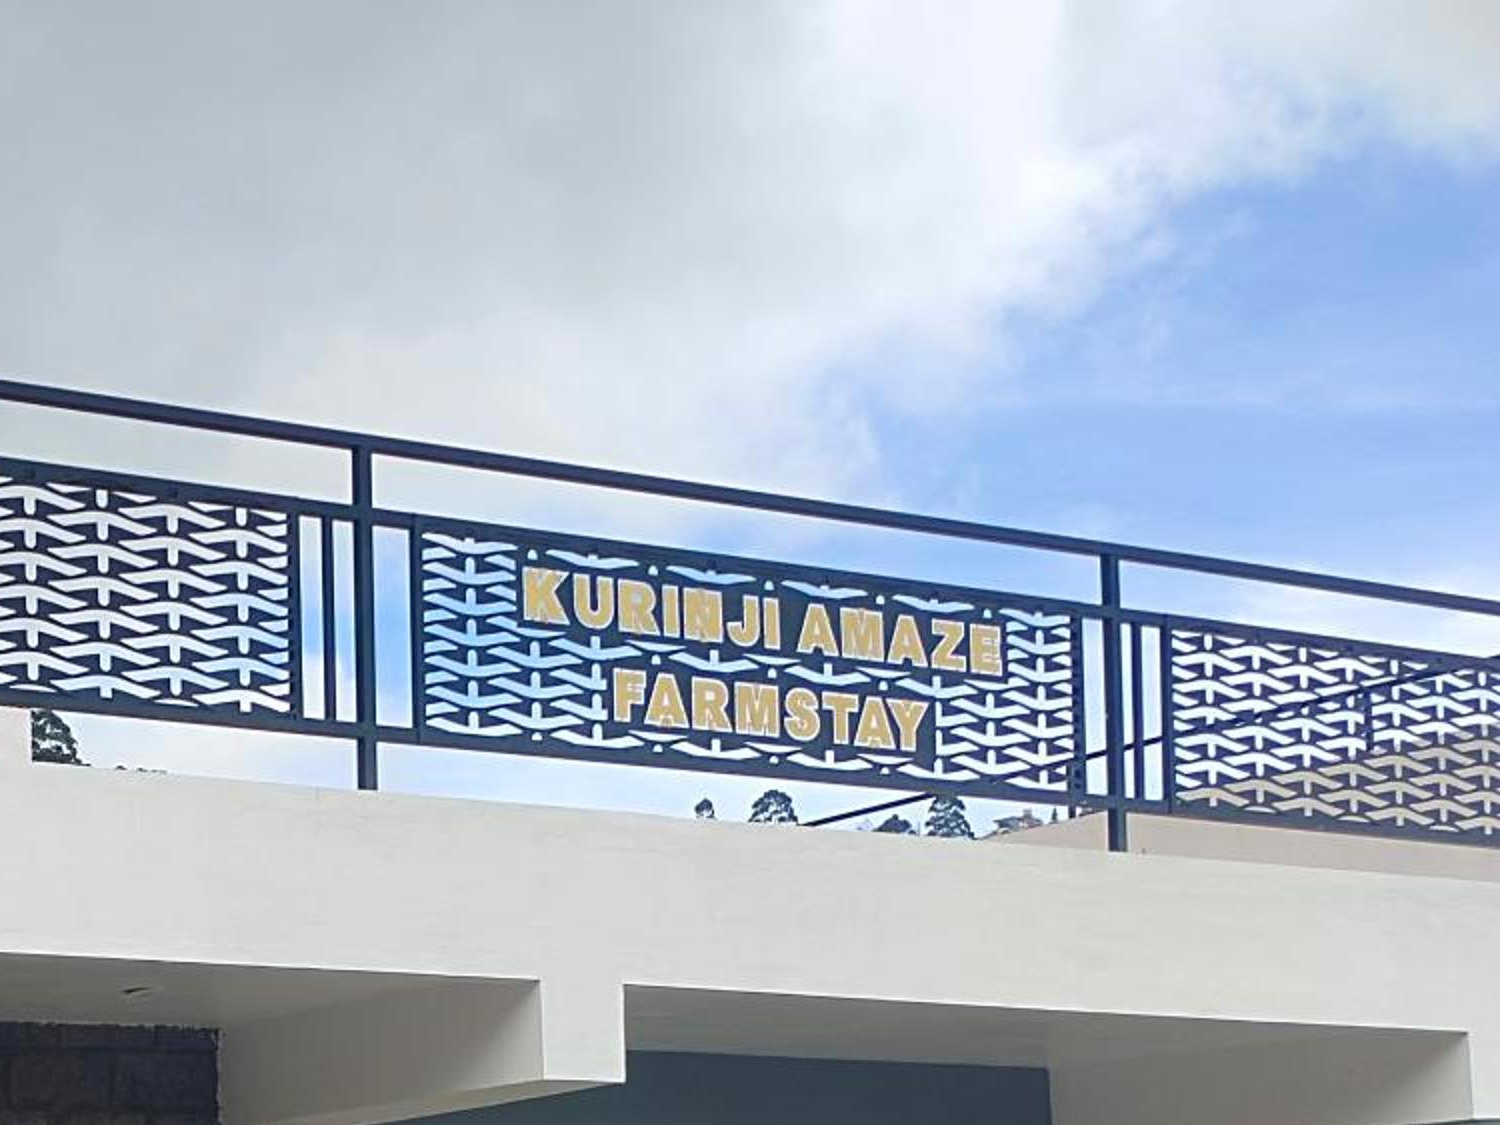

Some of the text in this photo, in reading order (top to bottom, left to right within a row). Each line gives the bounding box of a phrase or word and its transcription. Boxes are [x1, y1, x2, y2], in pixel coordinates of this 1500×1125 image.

[522, 566, 1003, 676] KURINJI AMAZE
[613, 667, 929, 752] FARMSTAY
